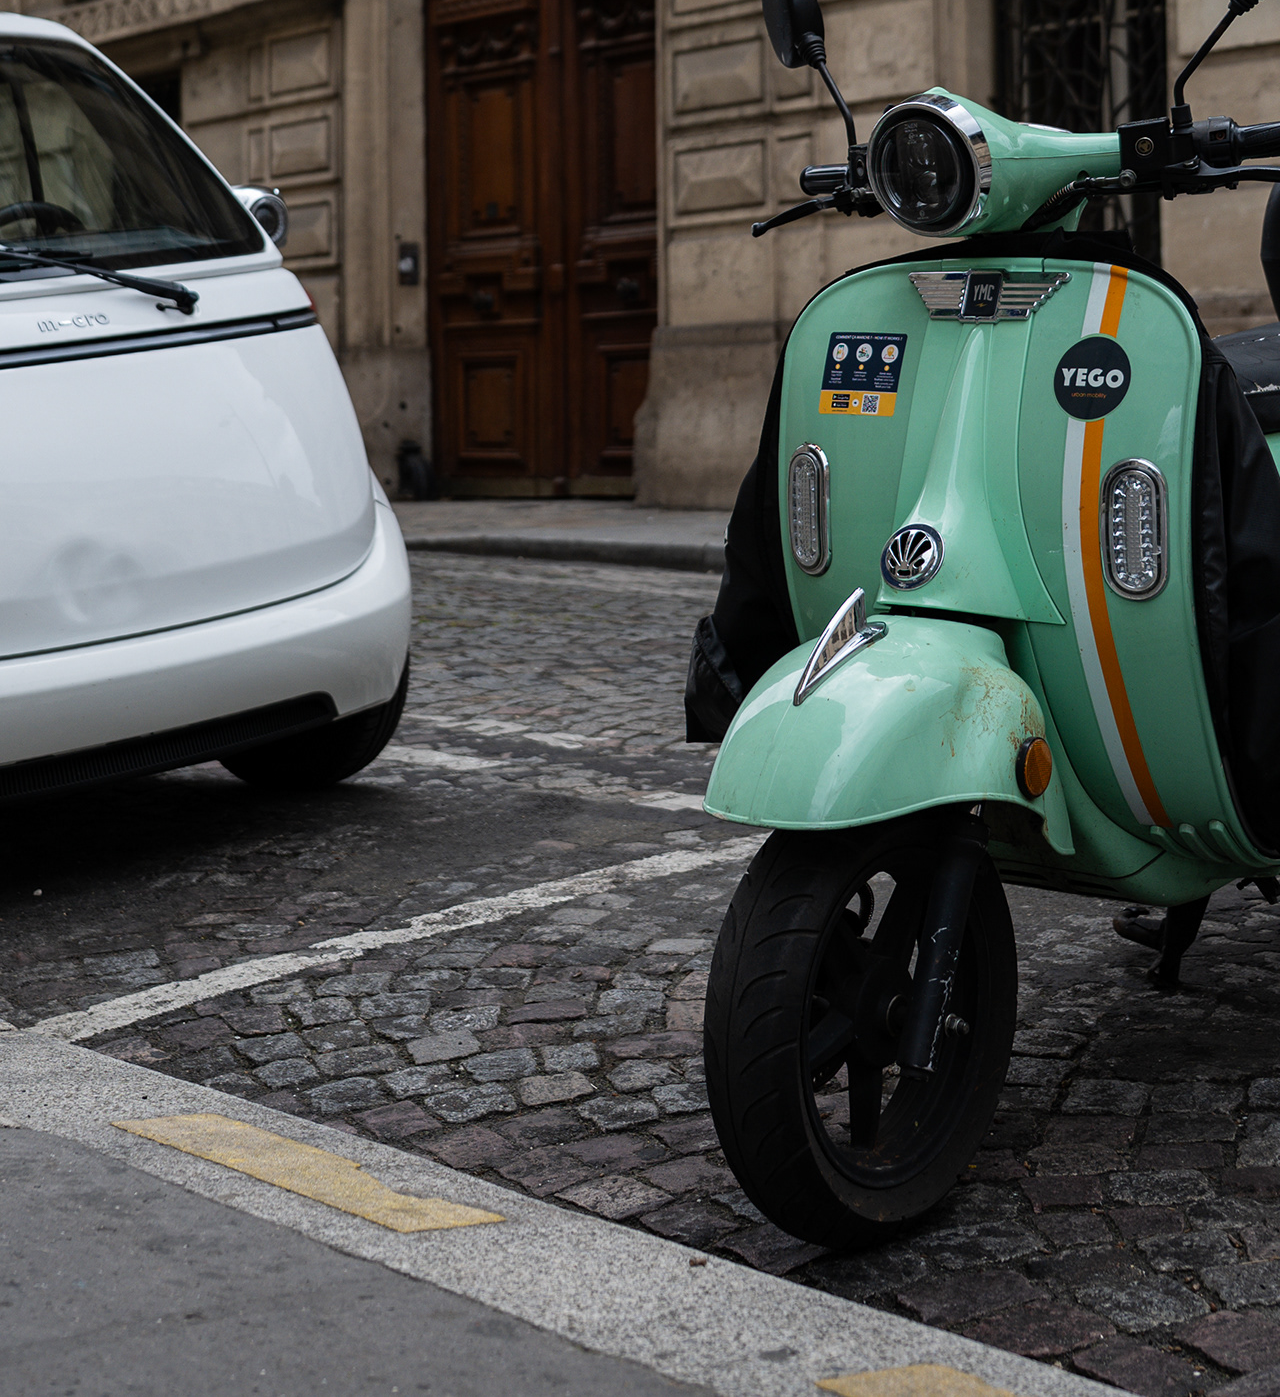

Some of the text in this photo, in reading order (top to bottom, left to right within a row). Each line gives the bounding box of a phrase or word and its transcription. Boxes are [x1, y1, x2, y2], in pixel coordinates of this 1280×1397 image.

[973, 283, 995, 302] YMC
[1061, 368, 1124, 388] YEGO
[1086, 392, 1107, 400] mobility
